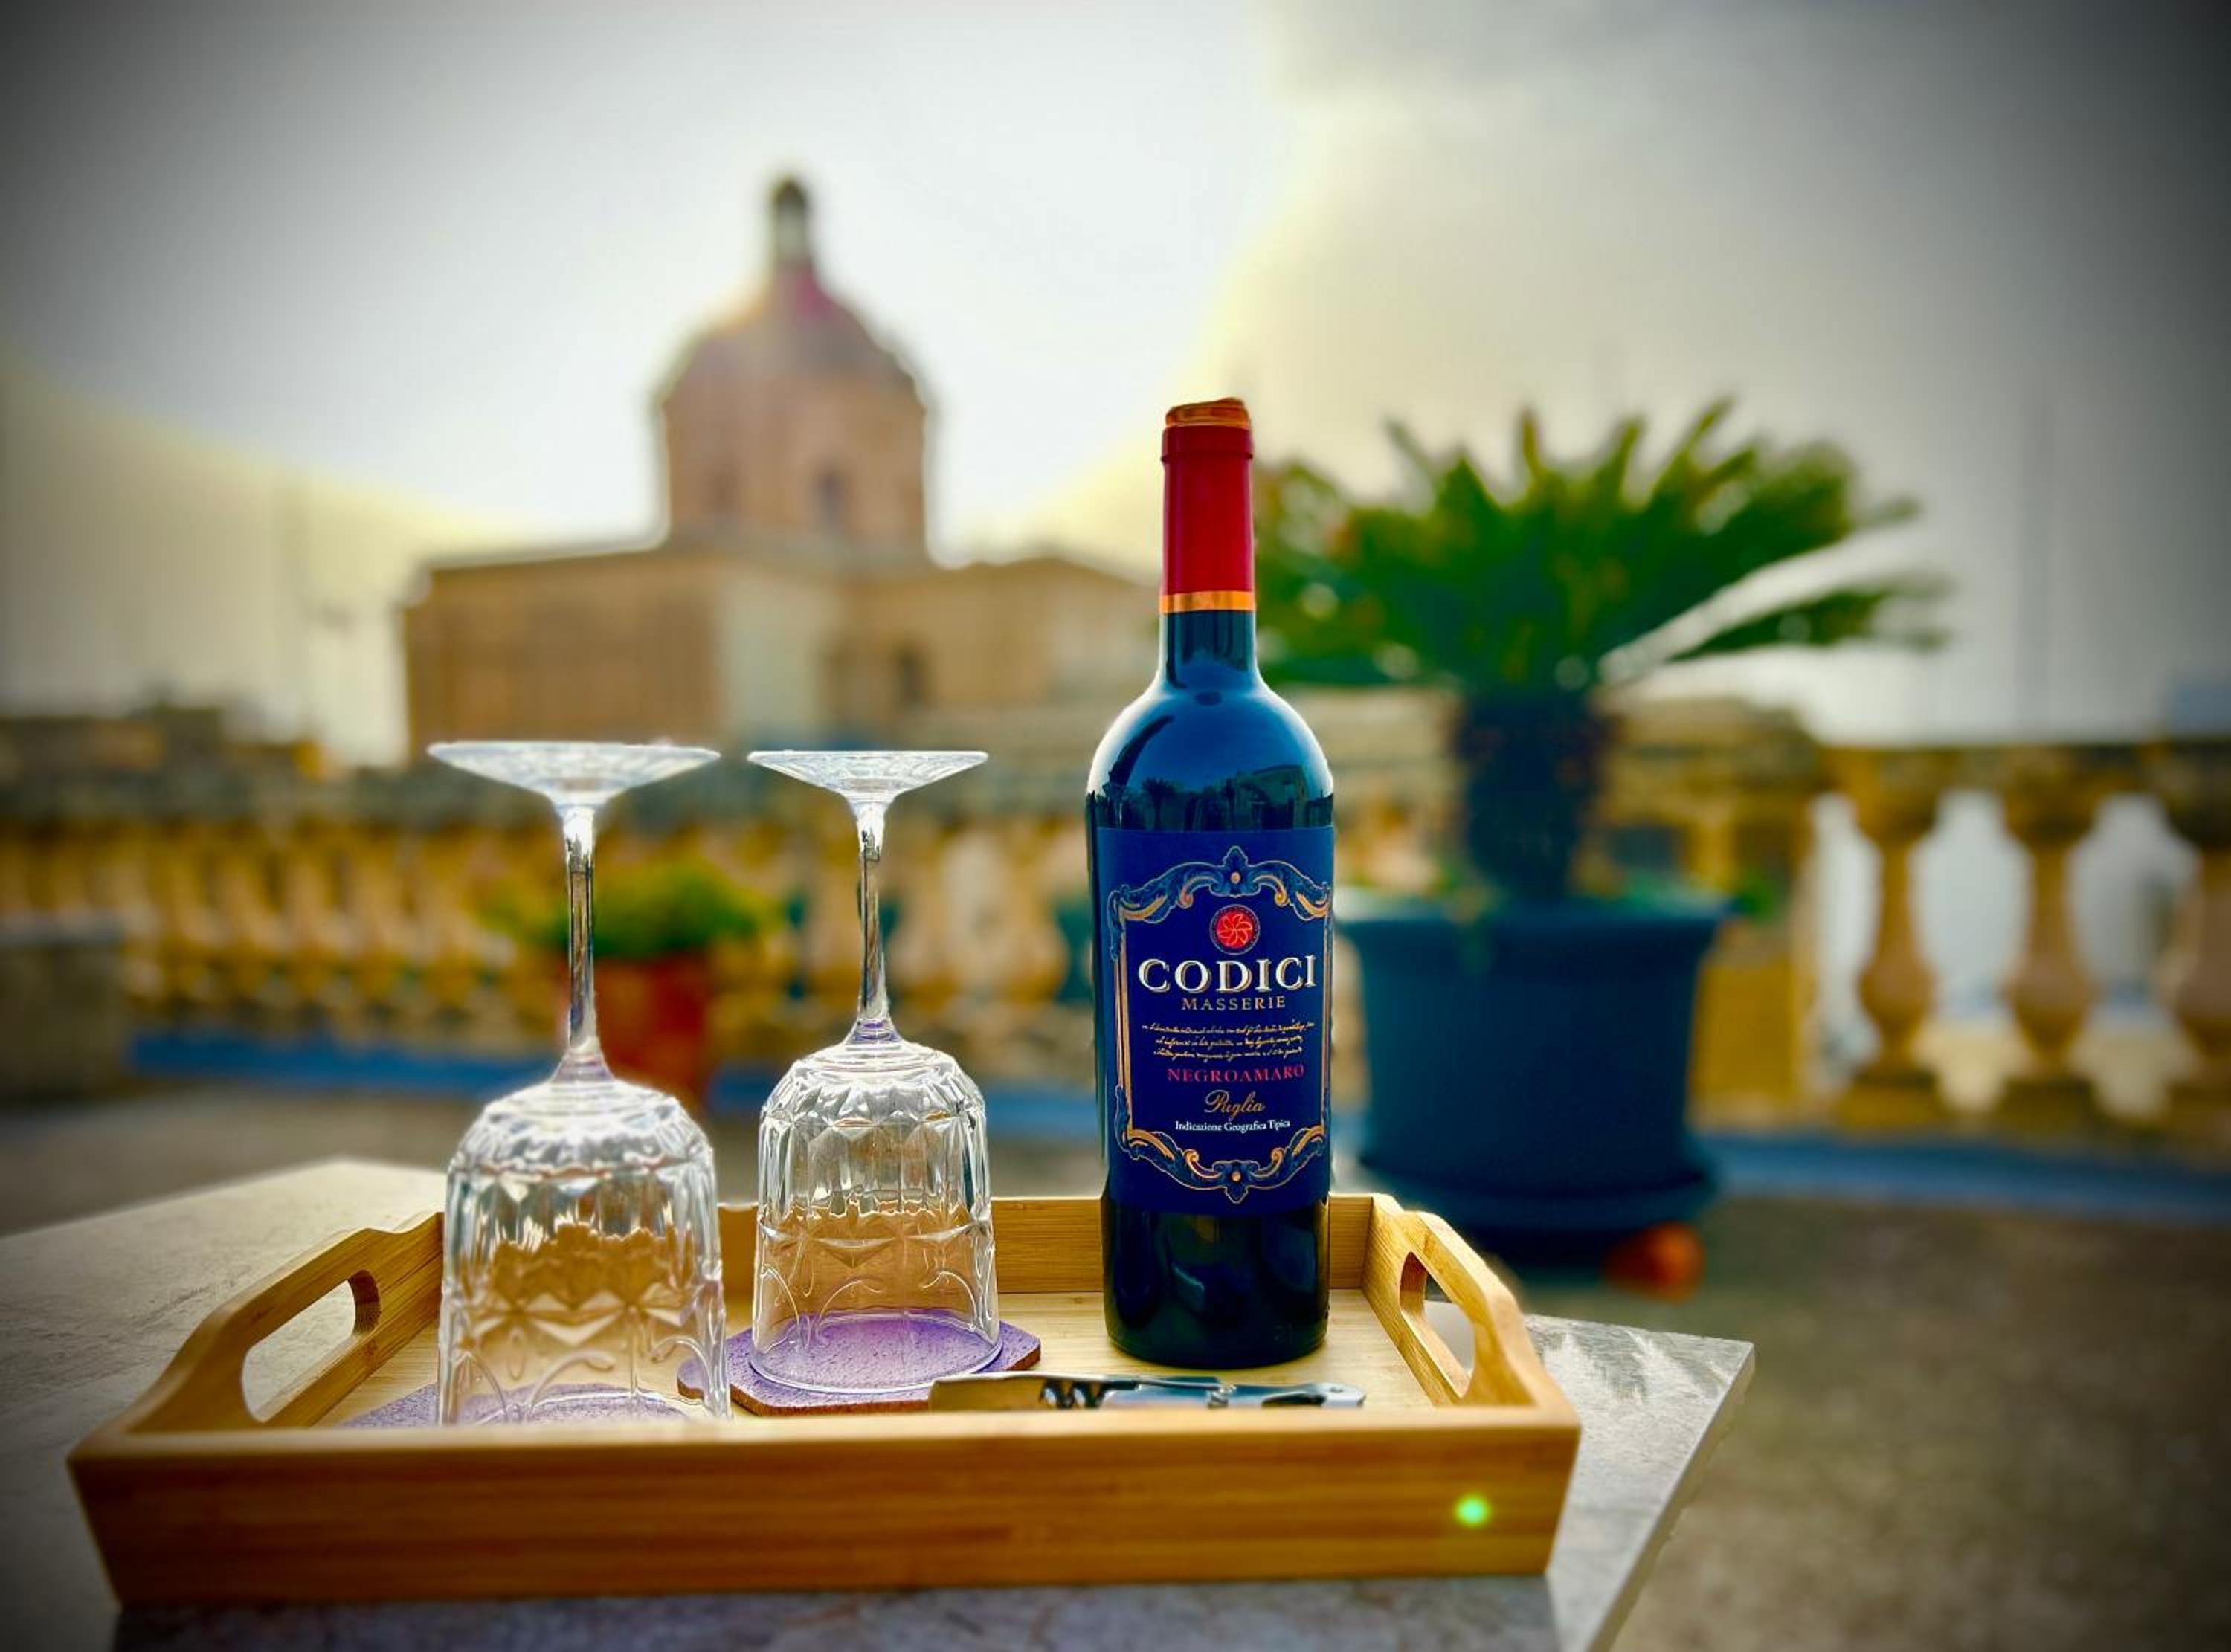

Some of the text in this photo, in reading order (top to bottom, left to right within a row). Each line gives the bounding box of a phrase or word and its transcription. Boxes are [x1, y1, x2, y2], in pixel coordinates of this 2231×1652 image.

[1138, 955, 1318, 993] CODICI
[1182, 996, 1286, 1011] MASSERIE
[1166, 1064, 1305, 1082] NEGROAMARO
[1204, 1089, 1266, 1120] Puglia
[1175, 1119, 1290, 1134] Indicazione Geografica Tipica
